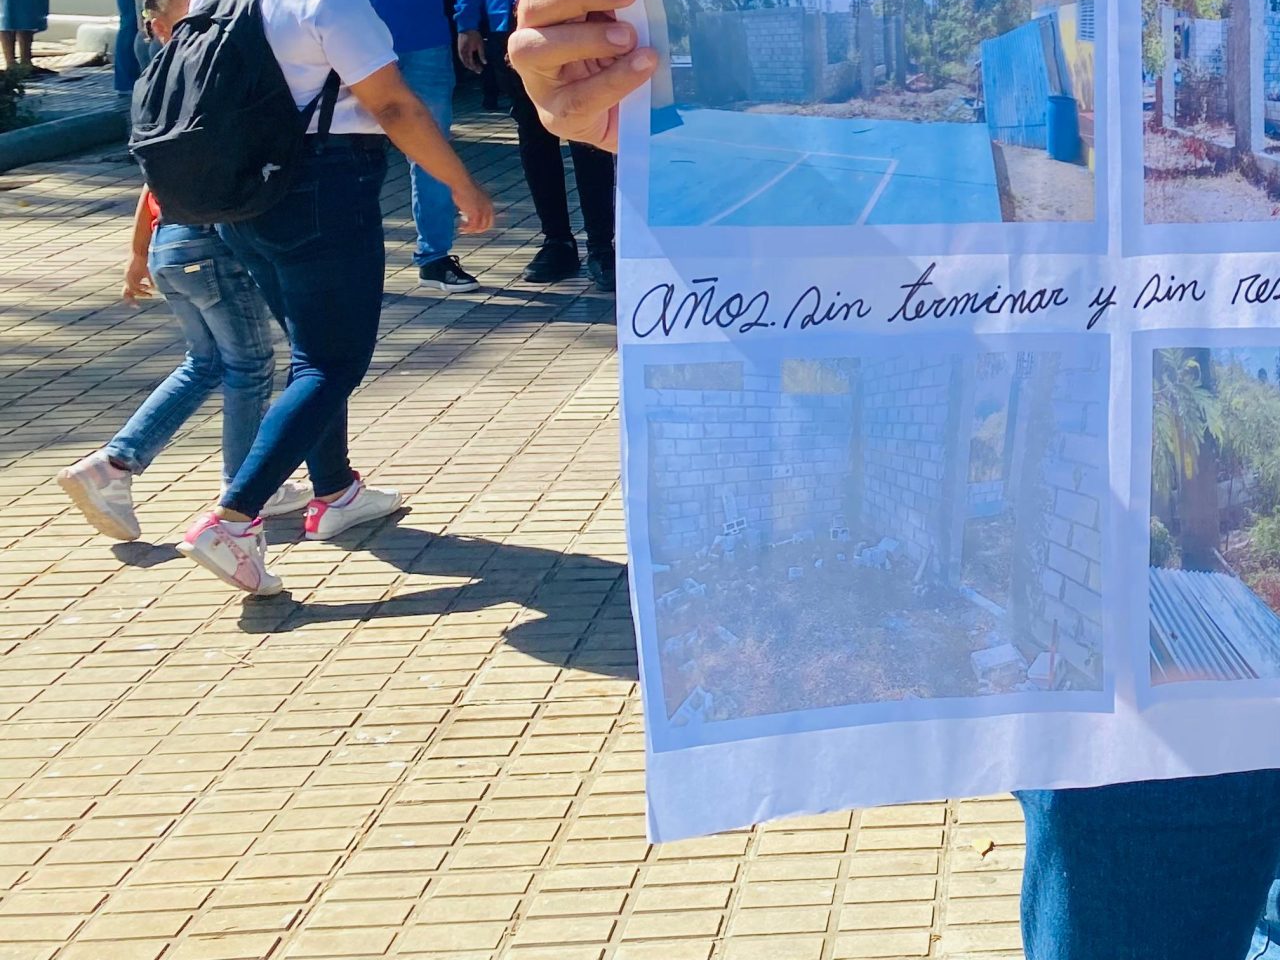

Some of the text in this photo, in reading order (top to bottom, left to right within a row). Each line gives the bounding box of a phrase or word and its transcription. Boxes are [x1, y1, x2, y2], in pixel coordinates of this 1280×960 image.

[782, 287, 872, 330] sin
[886, 261, 1069, 323] terminar
[1086, 285, 1117, 331] y
[1132, 273, 1207, 310] sin
